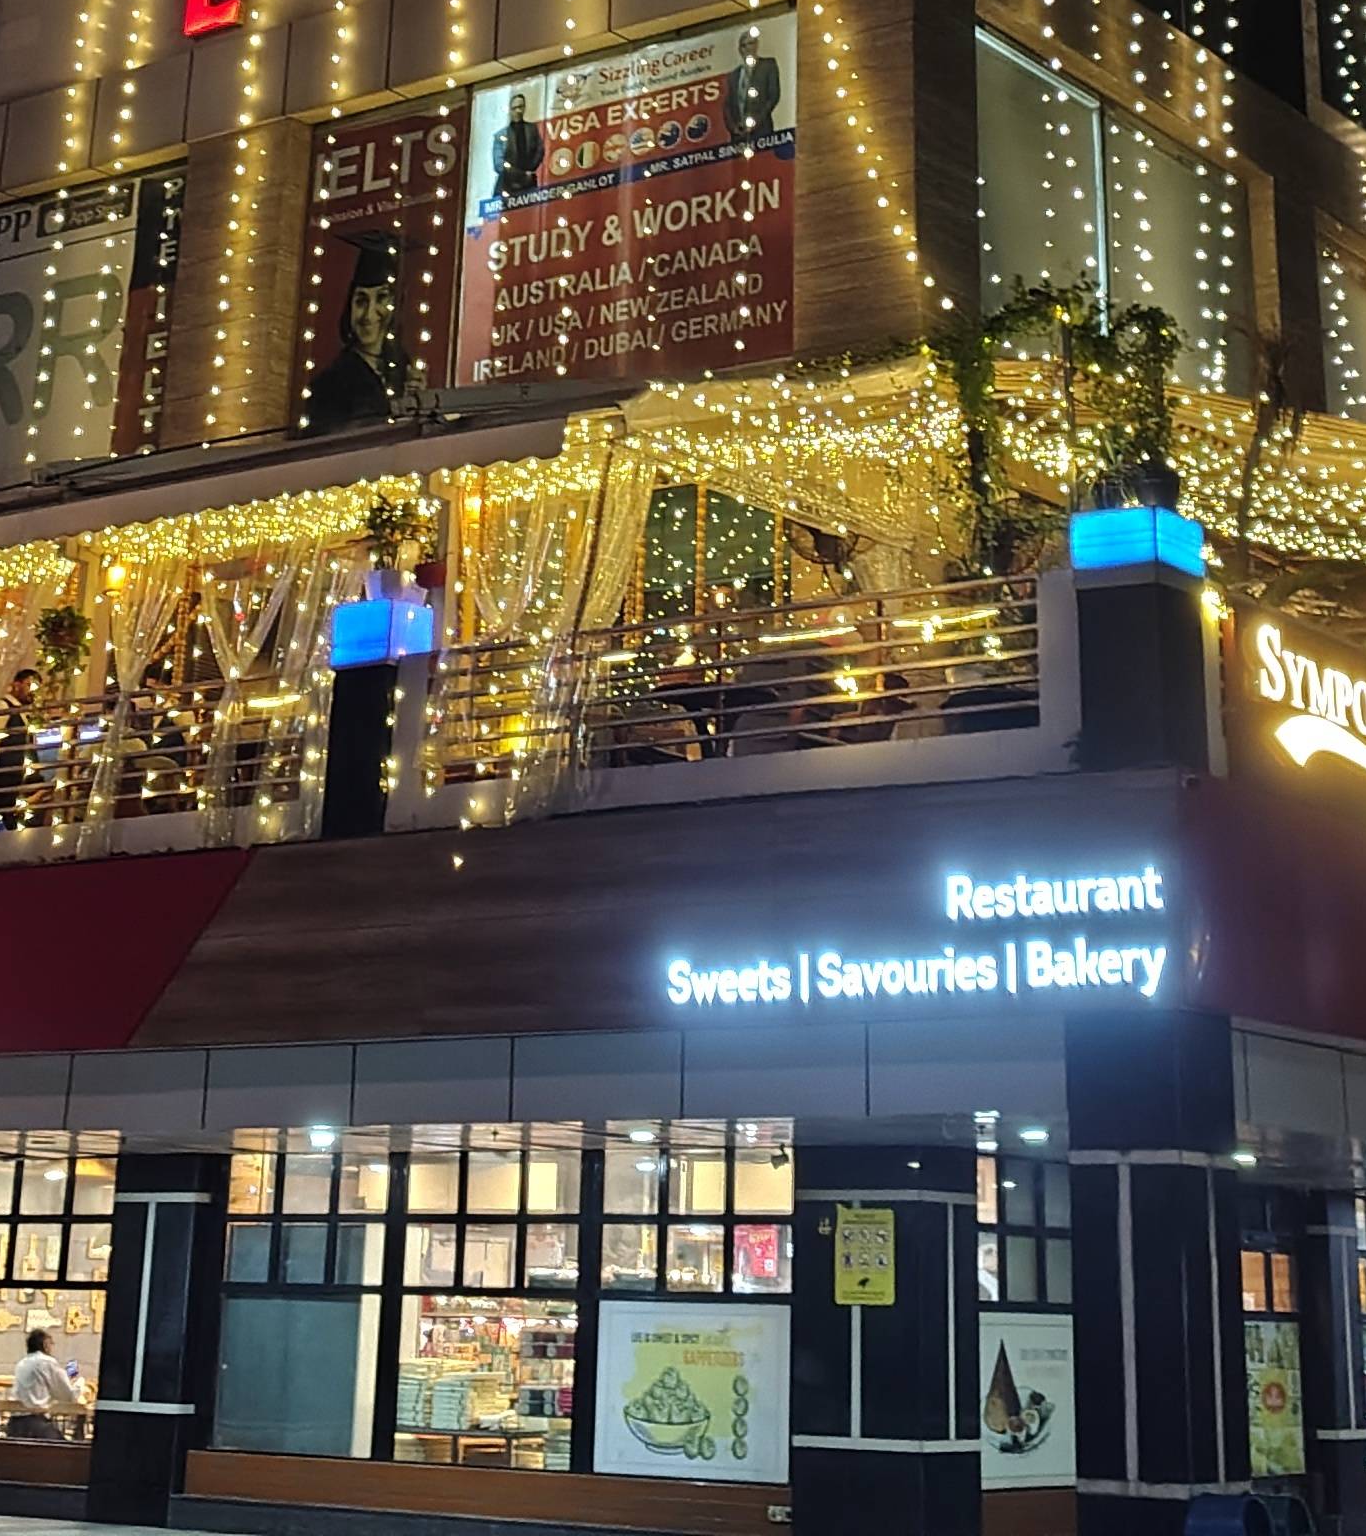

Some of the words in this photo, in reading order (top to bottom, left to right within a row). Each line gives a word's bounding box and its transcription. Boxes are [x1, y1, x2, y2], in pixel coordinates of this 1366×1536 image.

[597, 57, 661, 85] Sizzling
[662, 44, 716, 68] Career
[546, 112, 601, 141] VISA
[607, 81, 721, 125] EXPERTS
[313, 124, 457, 202] IELTS
[673, 152, 716, 168] SATPAL
[757, 132, 794, 148] GULIA
[487, 220, 594, 272] STUDY
[601, 214, 623, 246] &
[633, 188, 737, 239] WORK
[747, 178, 780, 216] IN
[496, 262, 633, 311] AUSTRALIA
[654, 235, 764, 278] CANADA
[473, 345, 566, 382] IRELAND
[585, 328, 653, 360] DUBAI
[671, 300, 787, 343] GERMANY
[492, 322, 519, 346] UK
[539, 311, 583, 337] USA
[599, 296, 650, 324] NEW
[656, 274, 763, 314] ZEALAND
[137, 290, 169, 453] IELT
[946, 866, 1166, 920] Restaurant
[667, 959, 792, 1004] Sweets
[816, 947, 999, 1000] Savouries
[1026, 936, 1167, 998] Bakery
